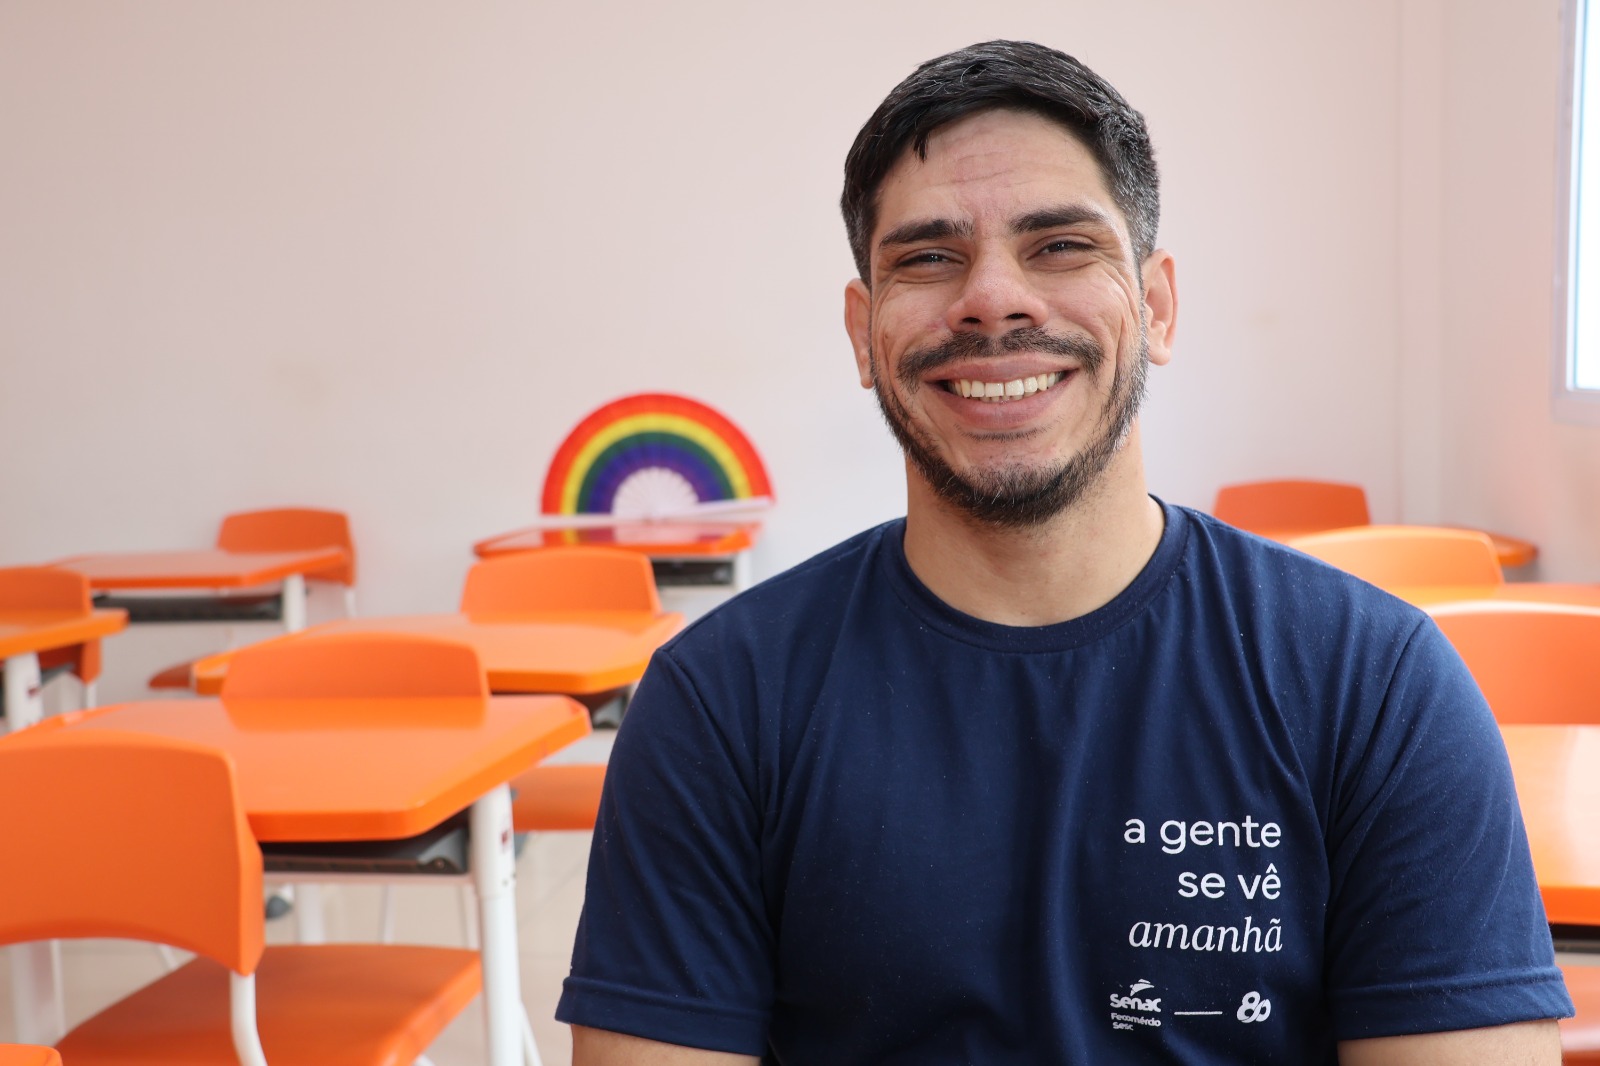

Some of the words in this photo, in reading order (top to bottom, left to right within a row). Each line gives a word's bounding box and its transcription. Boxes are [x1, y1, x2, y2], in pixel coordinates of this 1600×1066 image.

[1123, 818, 1146, 844] a
[1160, 815, 1282, 855] gente
[1178, 871, 1226, 899] se
[1237, 862, 1282, 900] vê
[1128, 916, 1283, 953] amanhã
